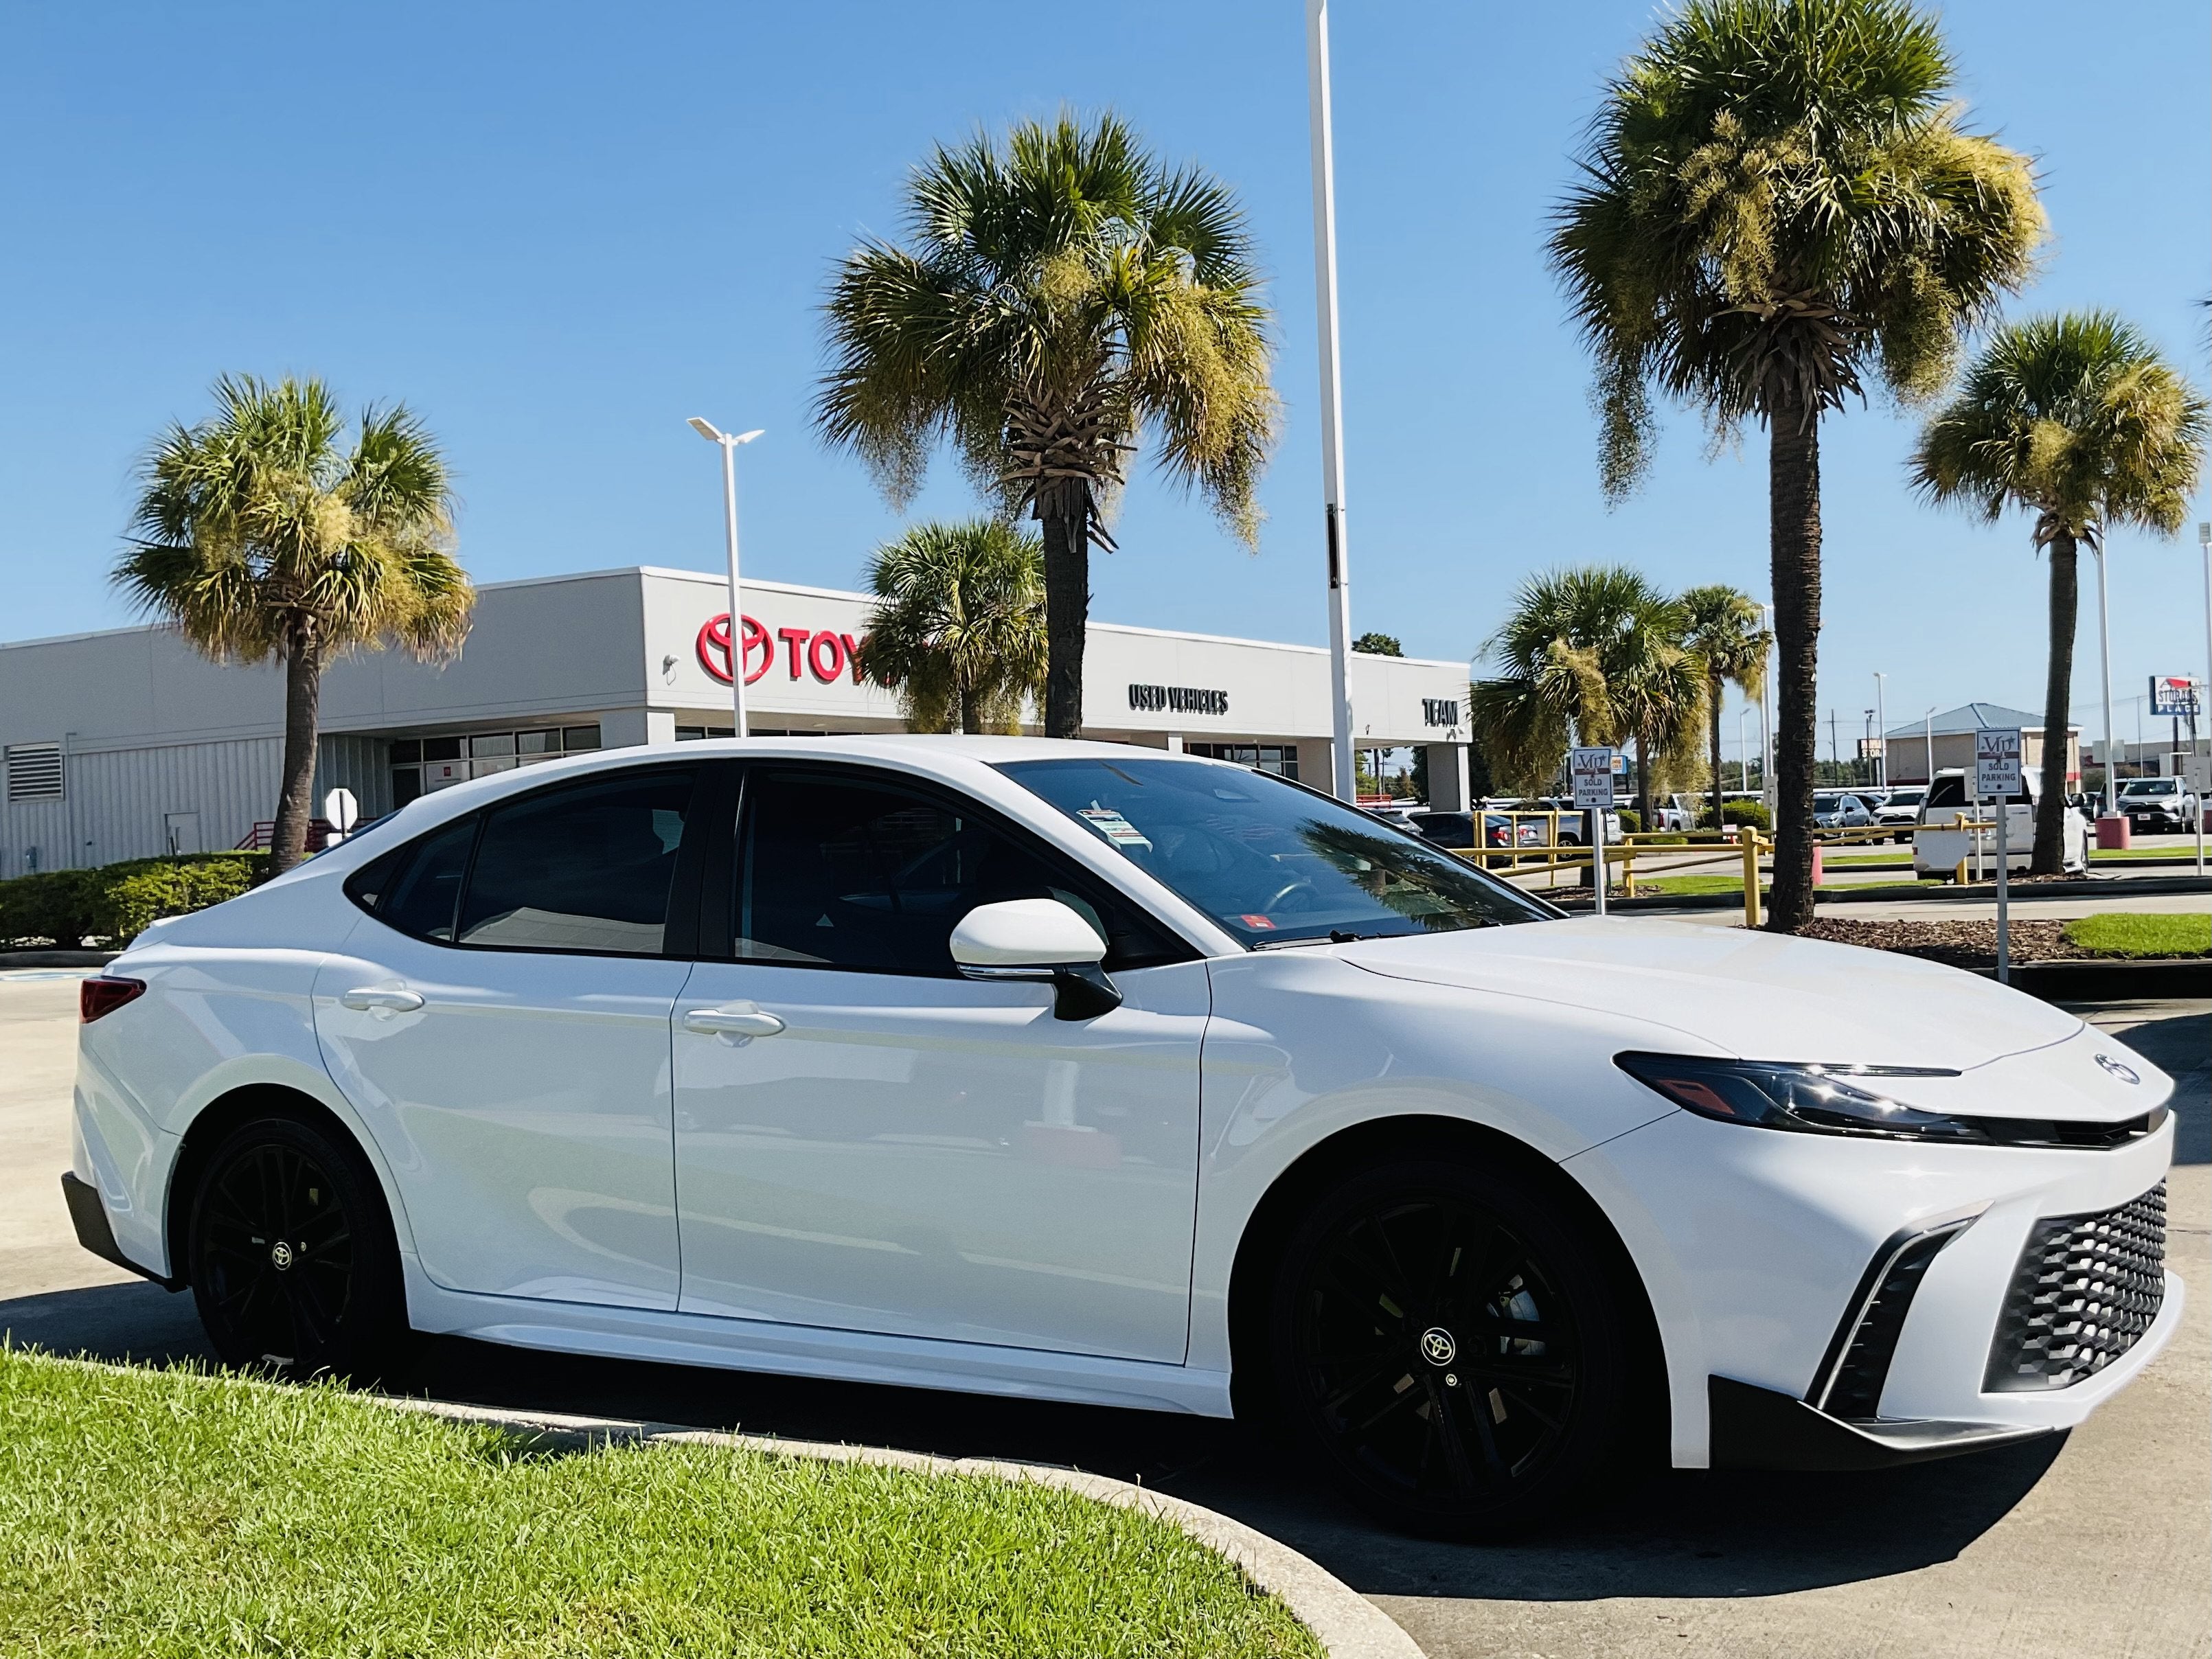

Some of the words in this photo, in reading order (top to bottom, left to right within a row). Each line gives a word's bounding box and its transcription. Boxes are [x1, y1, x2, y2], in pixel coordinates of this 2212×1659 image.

[779, 628, 897, 687] TOY
[1128, 684, 1166, 709] USED
[1167, 687, 1229, 713] VEHICLES
[1422, 698, 1458, 726] TEAM
[2158, 705, 2198, 713] PLACE
[1988, 762, 2009, 770] SOLD
[1981, 773, 2016, 781] PARKING
[1578, 788, 1608, 797] PARKING
